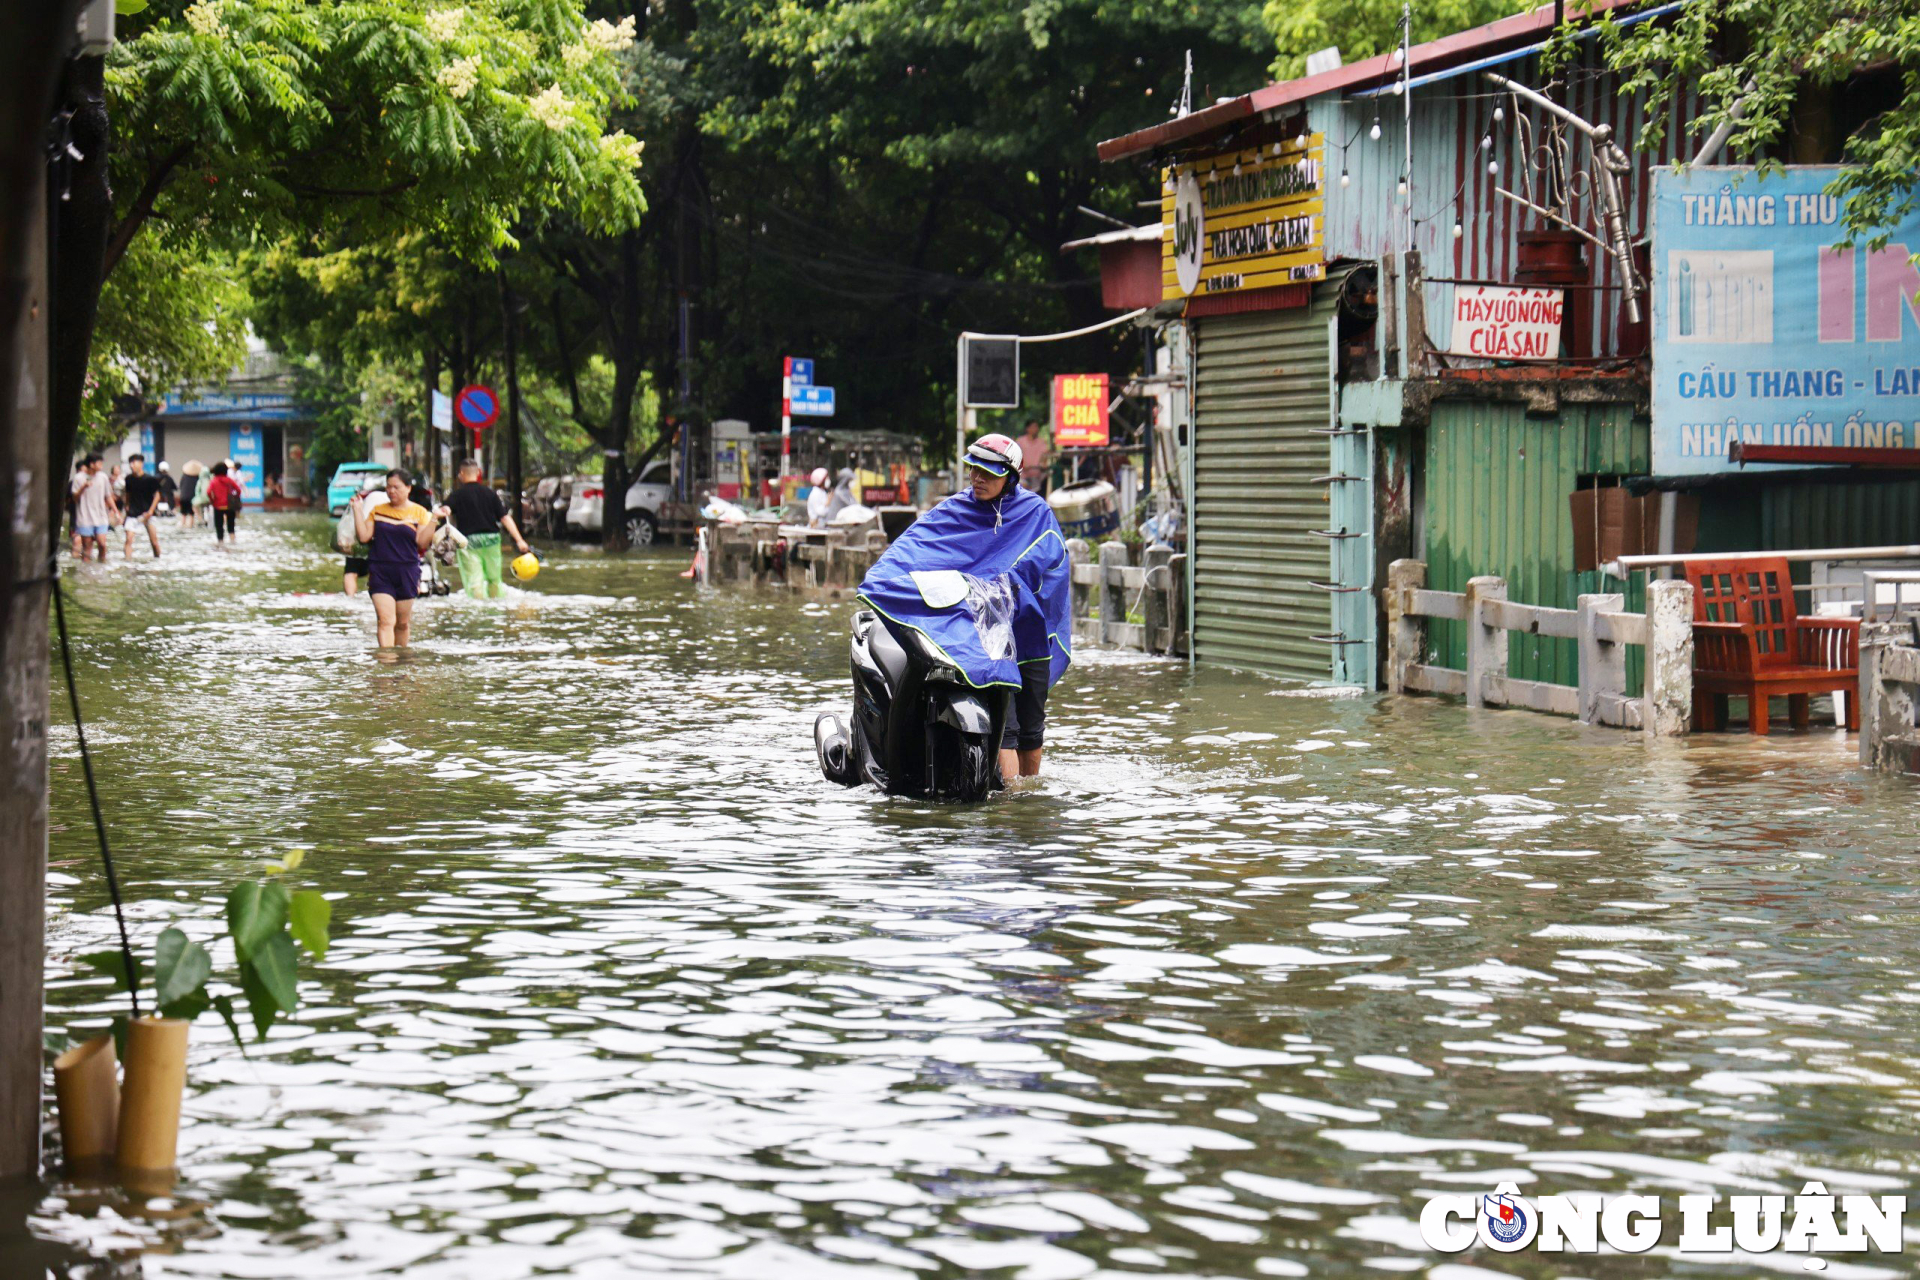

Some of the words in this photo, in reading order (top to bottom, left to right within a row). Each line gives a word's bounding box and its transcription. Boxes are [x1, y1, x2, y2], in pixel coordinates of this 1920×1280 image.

[1682, 185, 1776, 227] THẮNG
[1062, 374, 1102, 400] BÚN
[1678, 361, 1737, 399] CẦU
[1746, 370, 1844, 398] THANG
[1062, 400, 1101, 427] CHẢ
